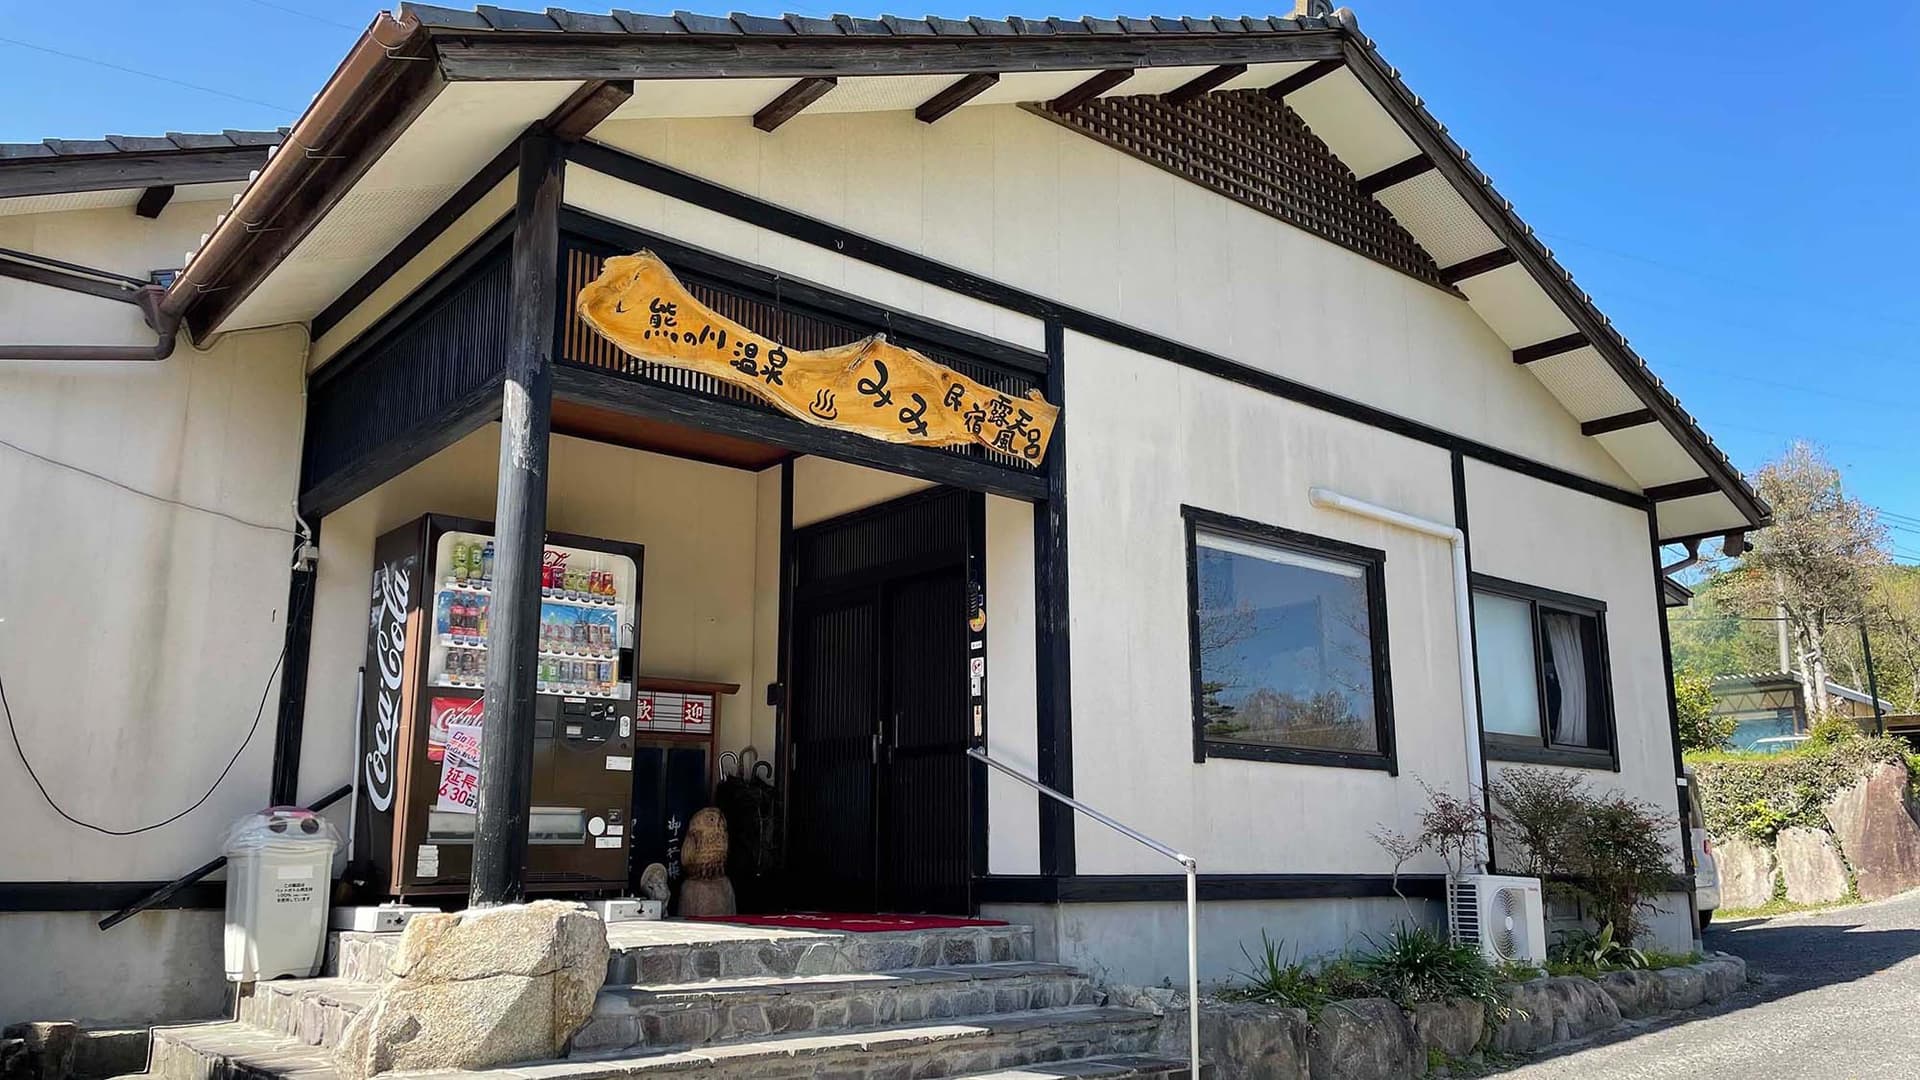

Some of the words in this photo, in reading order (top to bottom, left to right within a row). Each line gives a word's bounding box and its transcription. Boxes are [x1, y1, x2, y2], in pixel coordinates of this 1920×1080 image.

[644, 297, 789, 386] 熊の川温泉
[857, 359, 928, 437] みみ
[944, 383, 987, 436] 民宿
[365, 561, 411, 812] Coca-Cola
[445, 767, 477, 792] 延長
